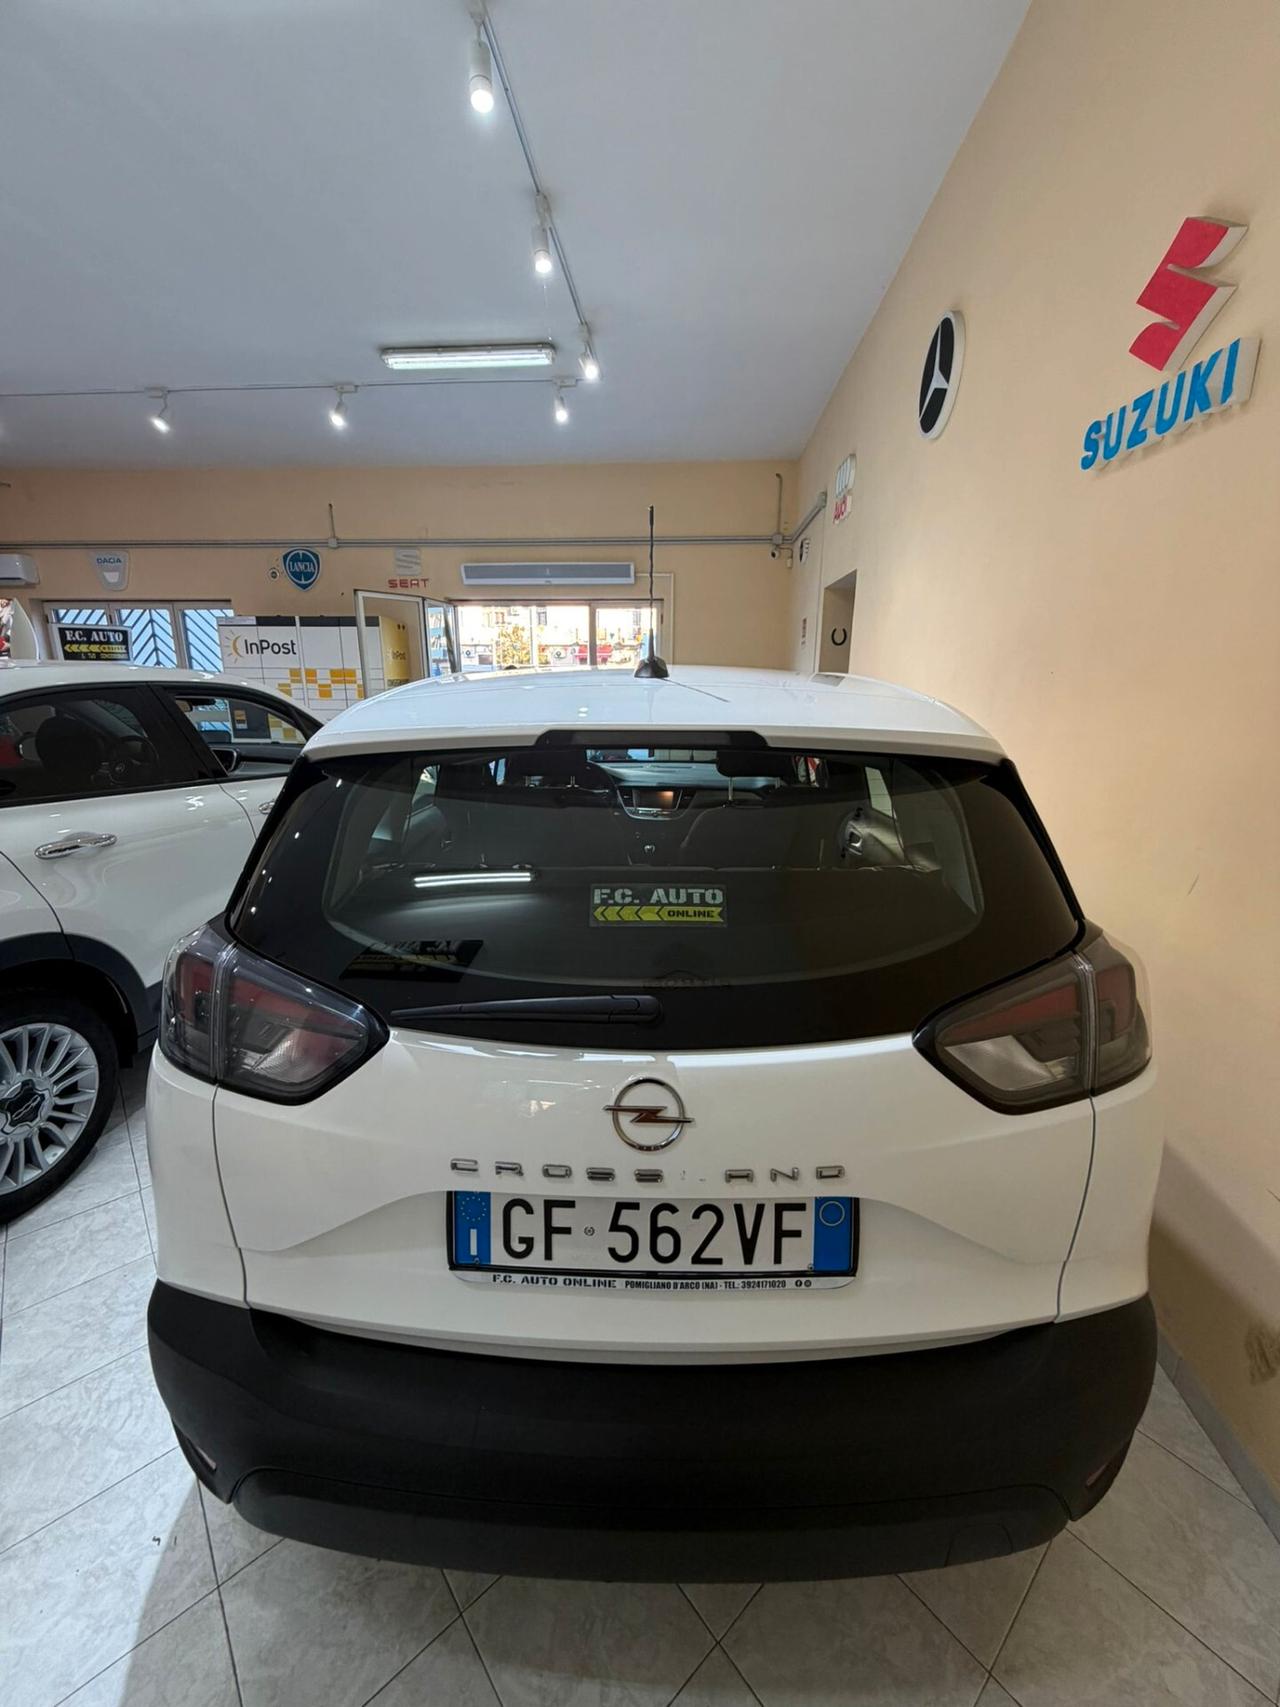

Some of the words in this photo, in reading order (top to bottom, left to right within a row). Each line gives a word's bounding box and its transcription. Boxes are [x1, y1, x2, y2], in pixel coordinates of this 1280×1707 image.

[1081, 337, 1241, 470] SUZUKI
[96, 557, 122, 565] DACIA
[289, 561, 315, 573] LANCIA
[388, 578, 429, 589] SEAT
[91, 631, 123, 642] AUTO
[244, 639, 297, 656] InPost
[593, 888, 639, 904] F.C.
[650, 888, 723, 904] AUTO
[667, 909, 714, 918] ONLINE
[450, 1158, 845, 1183] CROSSAND
[502, 1198, 576, 1261] GF
[492, 1274, 516, 1284] F.C.
[521, 1276, 558, 1286] AUTO
[563, 1279, 616, 1289] ONLINE
[624, 1280, 671, 1290] POMIGLIANO
[673, 1281, 700, 1290] D'ARCO
[741, 1279, 787, 1289] 3924171020
